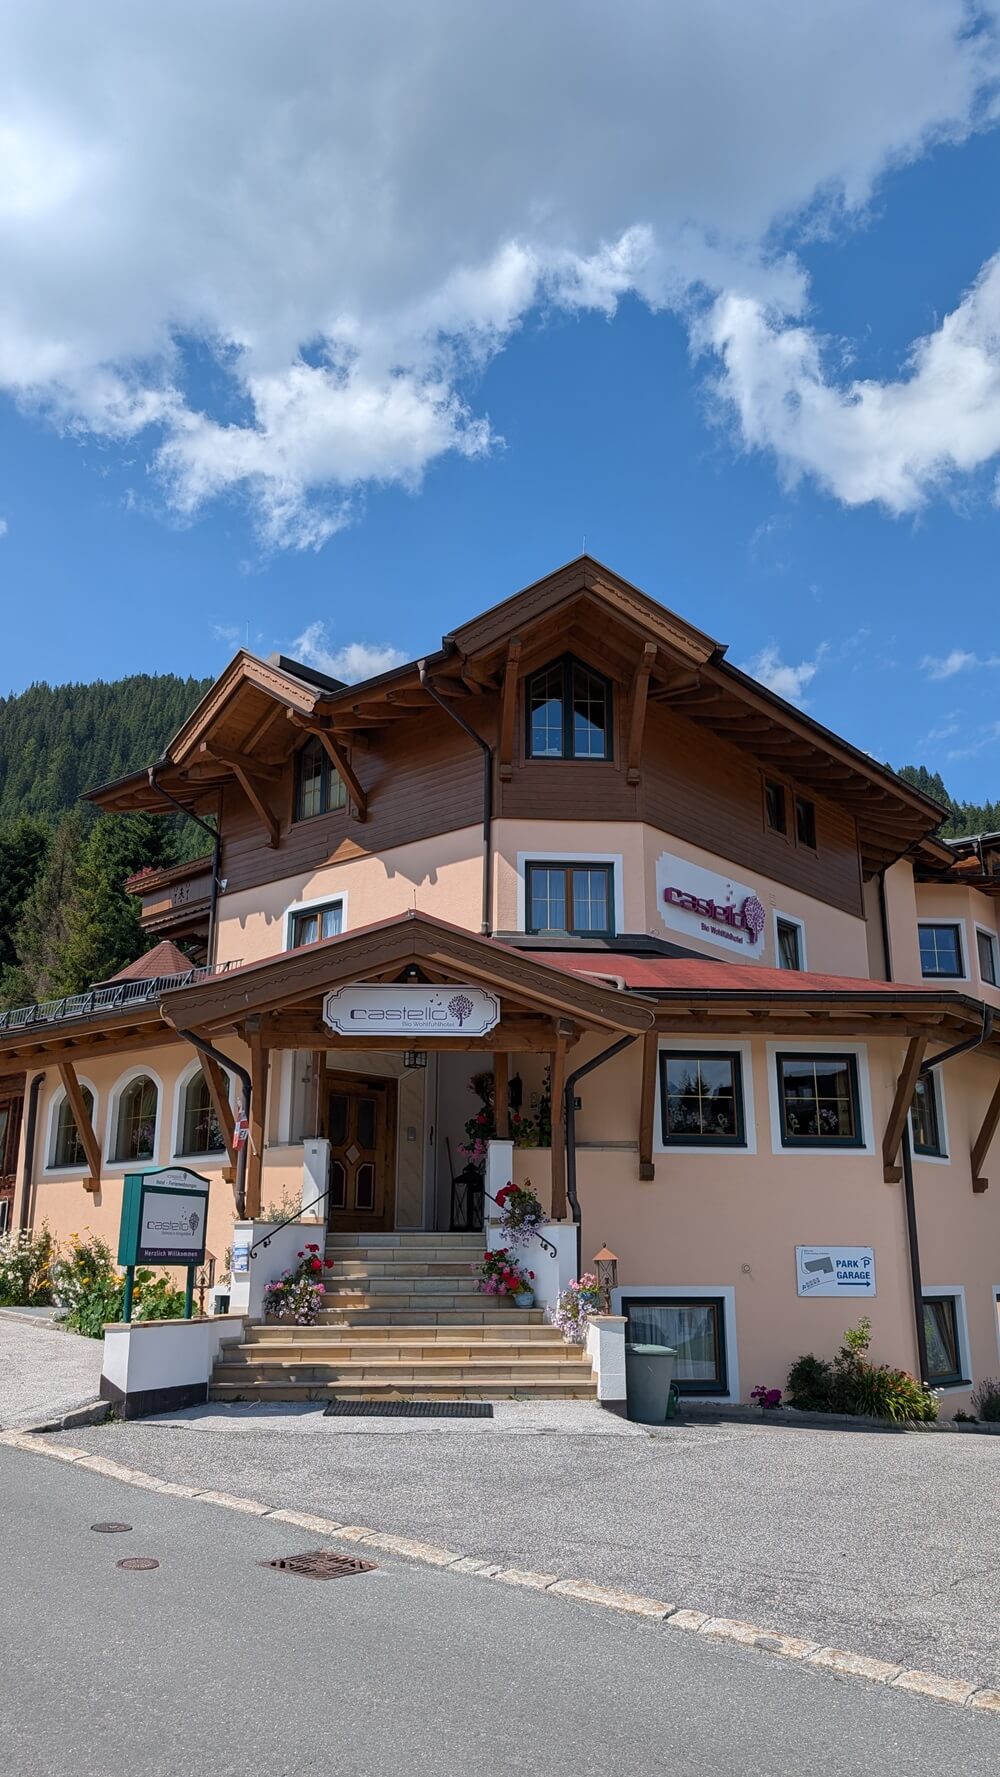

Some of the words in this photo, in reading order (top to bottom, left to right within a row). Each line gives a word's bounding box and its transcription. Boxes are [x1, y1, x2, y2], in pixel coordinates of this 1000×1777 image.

[701, 922, 709, 932] Bio
[350, 1007, 448, 1021] castello
[147, 1220, 188, 1231] castello
[144, 1249, 166, 1257] Herzlich
[836, 1260, 859, 1268] PARK
[836, 1271, 871, 1280] GARAGE
